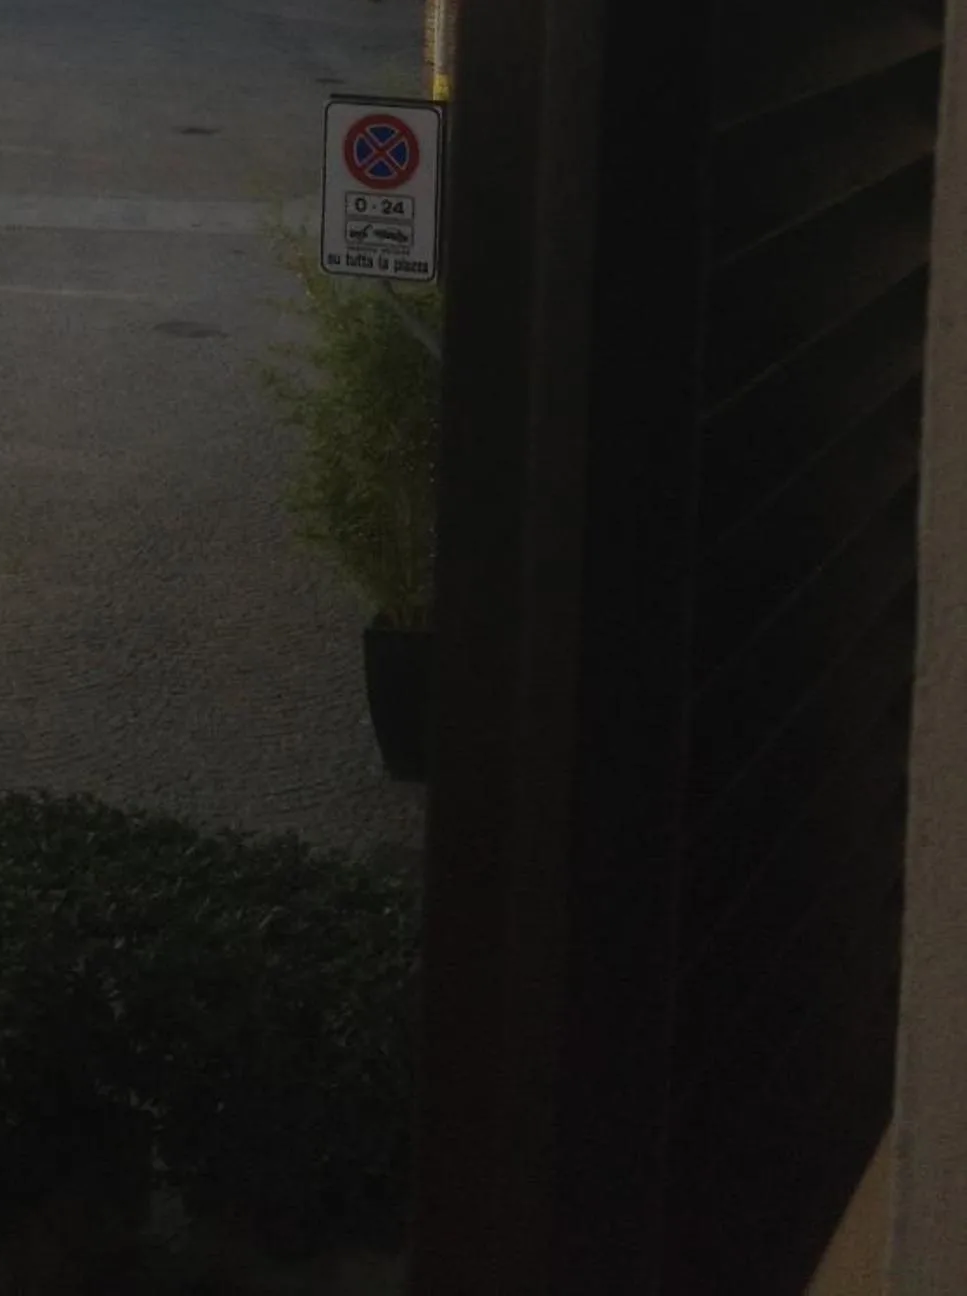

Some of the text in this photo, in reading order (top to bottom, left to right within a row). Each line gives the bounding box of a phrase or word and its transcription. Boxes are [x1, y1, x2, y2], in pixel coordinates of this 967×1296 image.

[355, 197, 367, 212] 0
[381, 198, 405, 215] 24
[346, 252, 373, 268] tutta
[378, 254, 389, 271] la
